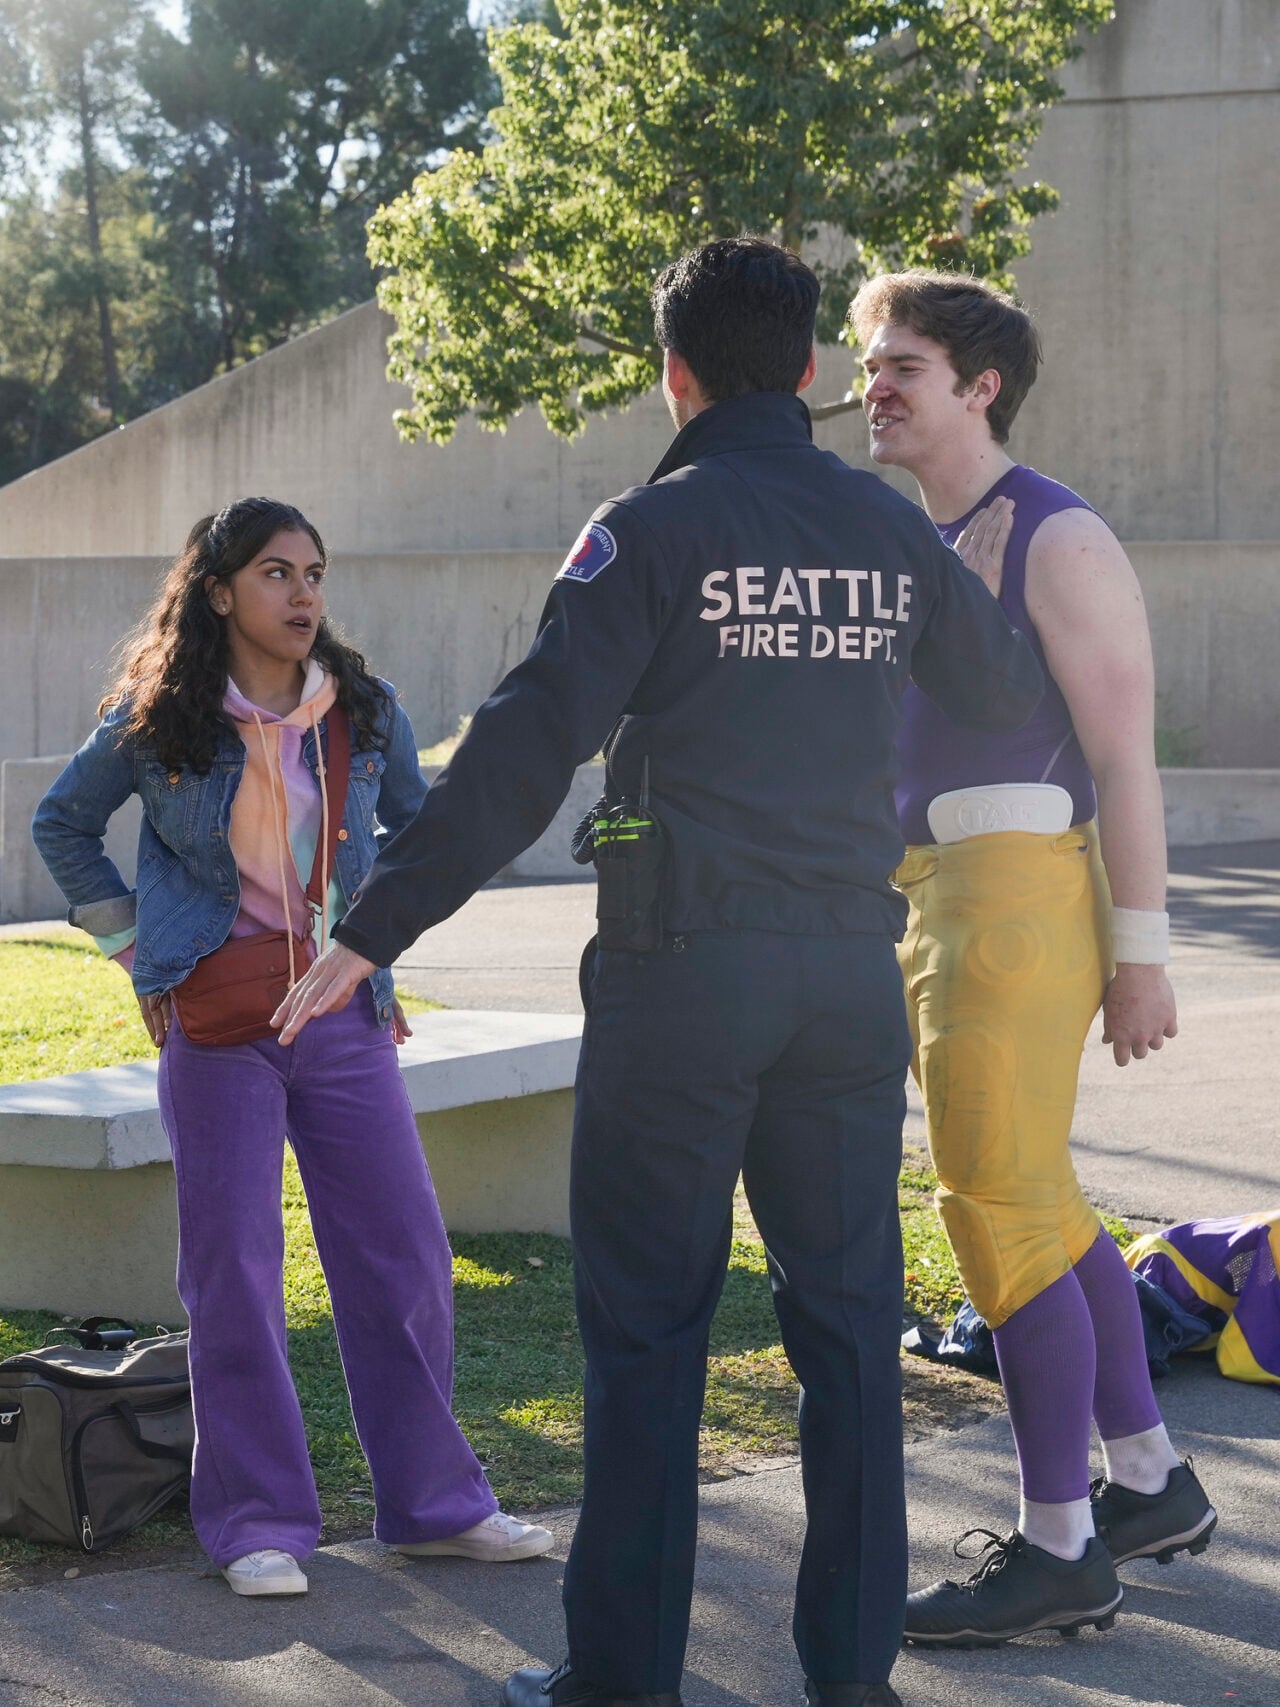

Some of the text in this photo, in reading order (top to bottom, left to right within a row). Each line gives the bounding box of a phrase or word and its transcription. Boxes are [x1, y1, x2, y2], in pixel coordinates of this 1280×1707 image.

[699, 566, 913, 623] SEATTLE
[717, 623, 897, 665] FIRE DEPT.
